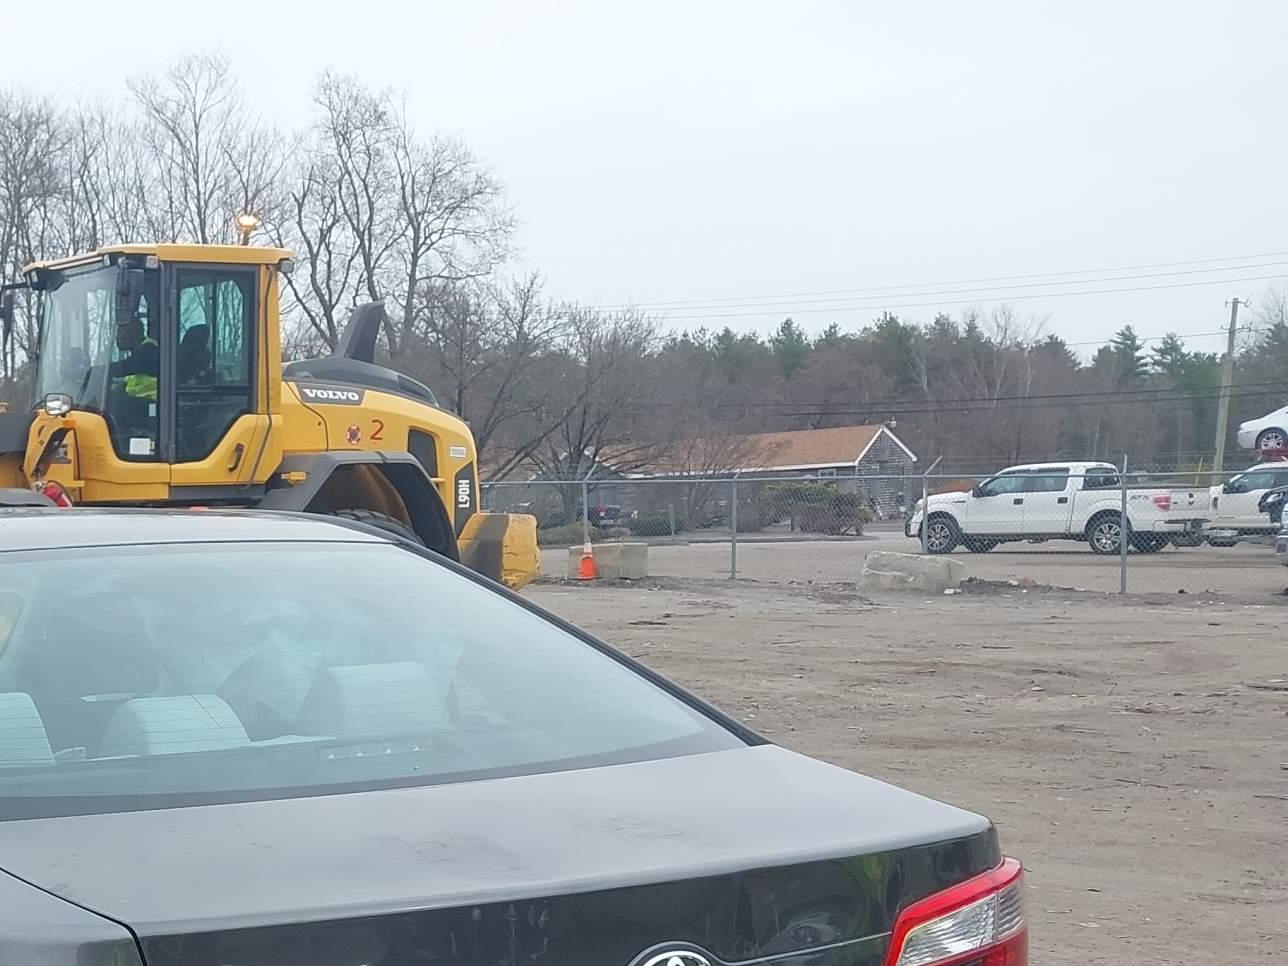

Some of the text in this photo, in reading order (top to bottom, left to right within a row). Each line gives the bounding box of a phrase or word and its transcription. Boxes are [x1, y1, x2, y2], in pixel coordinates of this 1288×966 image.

[302, 388, 360, 401] VOLVO
[369, 419, 384, 441] 2
[458, 479, 470, 508] L90H
